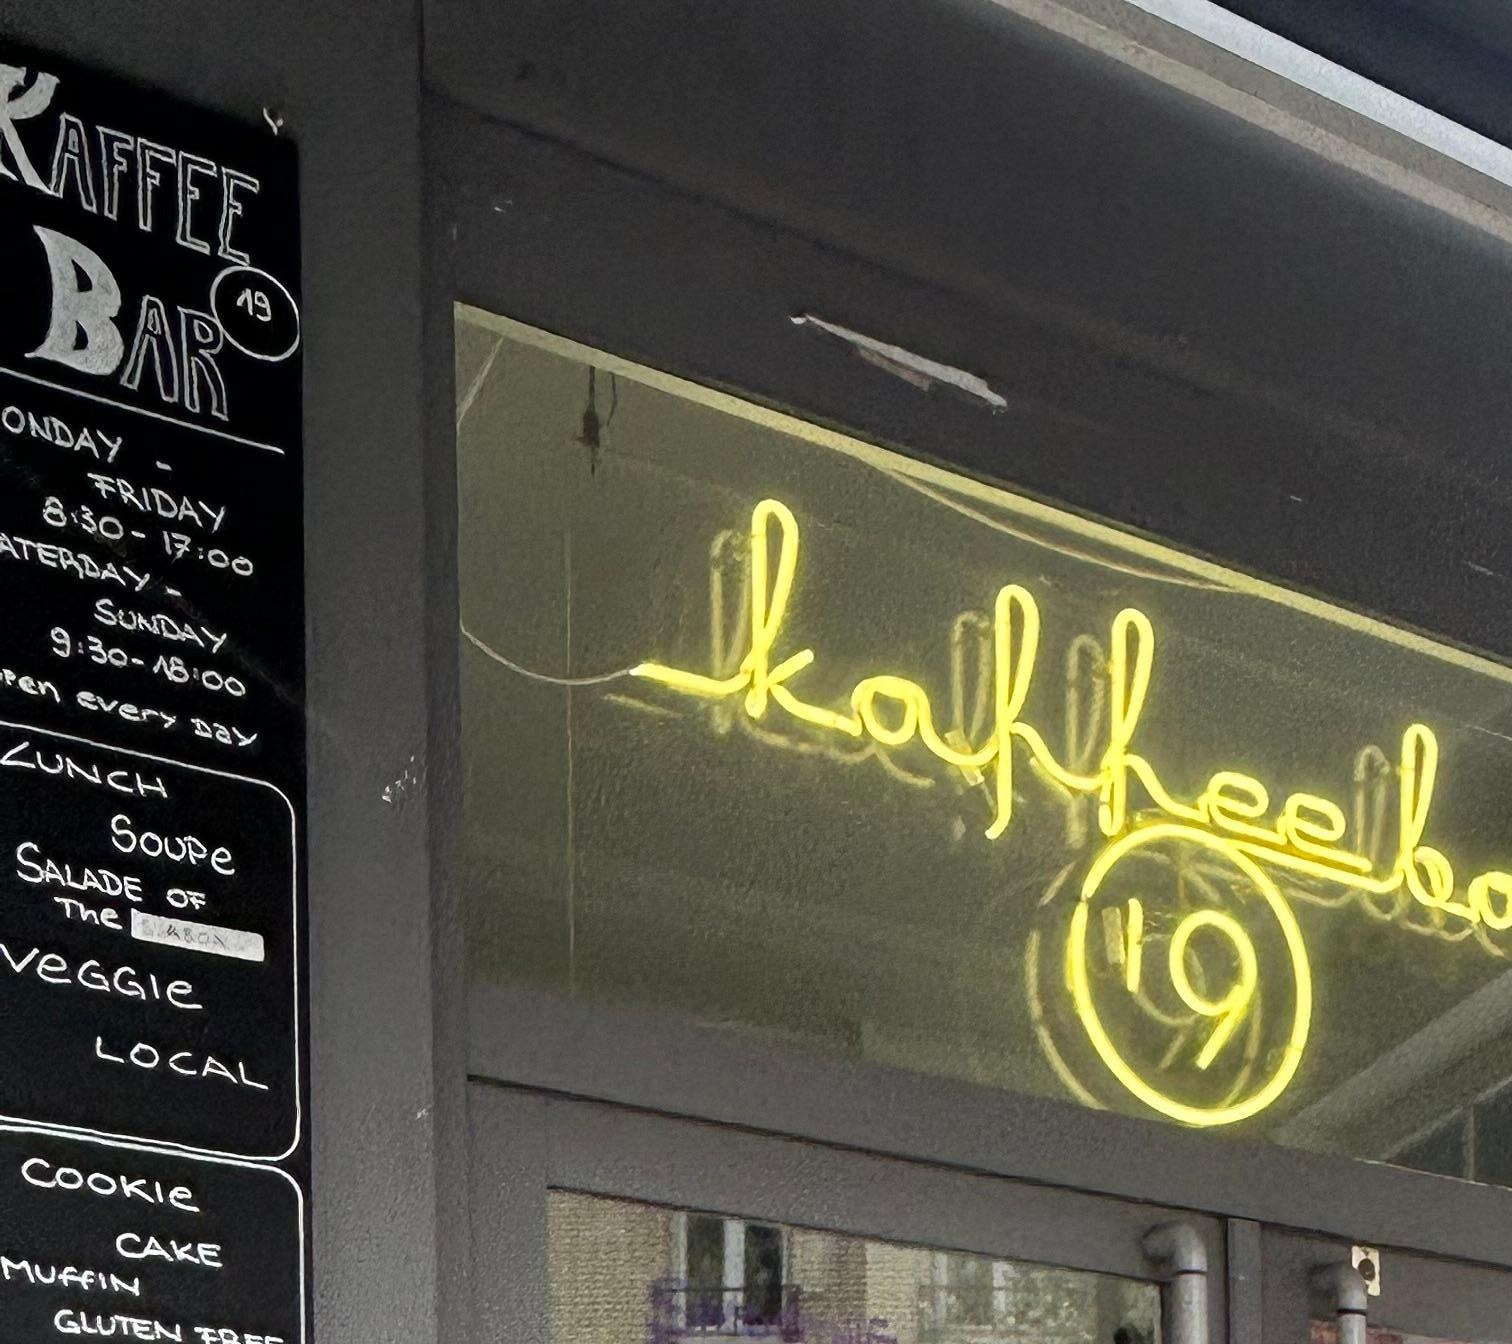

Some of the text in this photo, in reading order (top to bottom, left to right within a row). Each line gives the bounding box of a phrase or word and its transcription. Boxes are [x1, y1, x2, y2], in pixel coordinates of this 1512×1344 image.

[24, 225, 229, 421] BAR
[236, 288, 272, 322] 19
[1, 406, 122, 463] ONDAY
[87, 472, 226, 534] FRIDAY
[0, 532, 150, 592] ATERDAY
[94, 598, 227, 654] SUNDAY
[0, 741, 168, 798] LUNCH
[16, 841, 207, 910] SALADE OF
[1122, 896, 1259, 1070] 19
[96, 1036, 269, 1090] LOCAL
[115, 1232, 223, 1268] CAKE
[54, 1308, 182, 1343] GLUTEN
